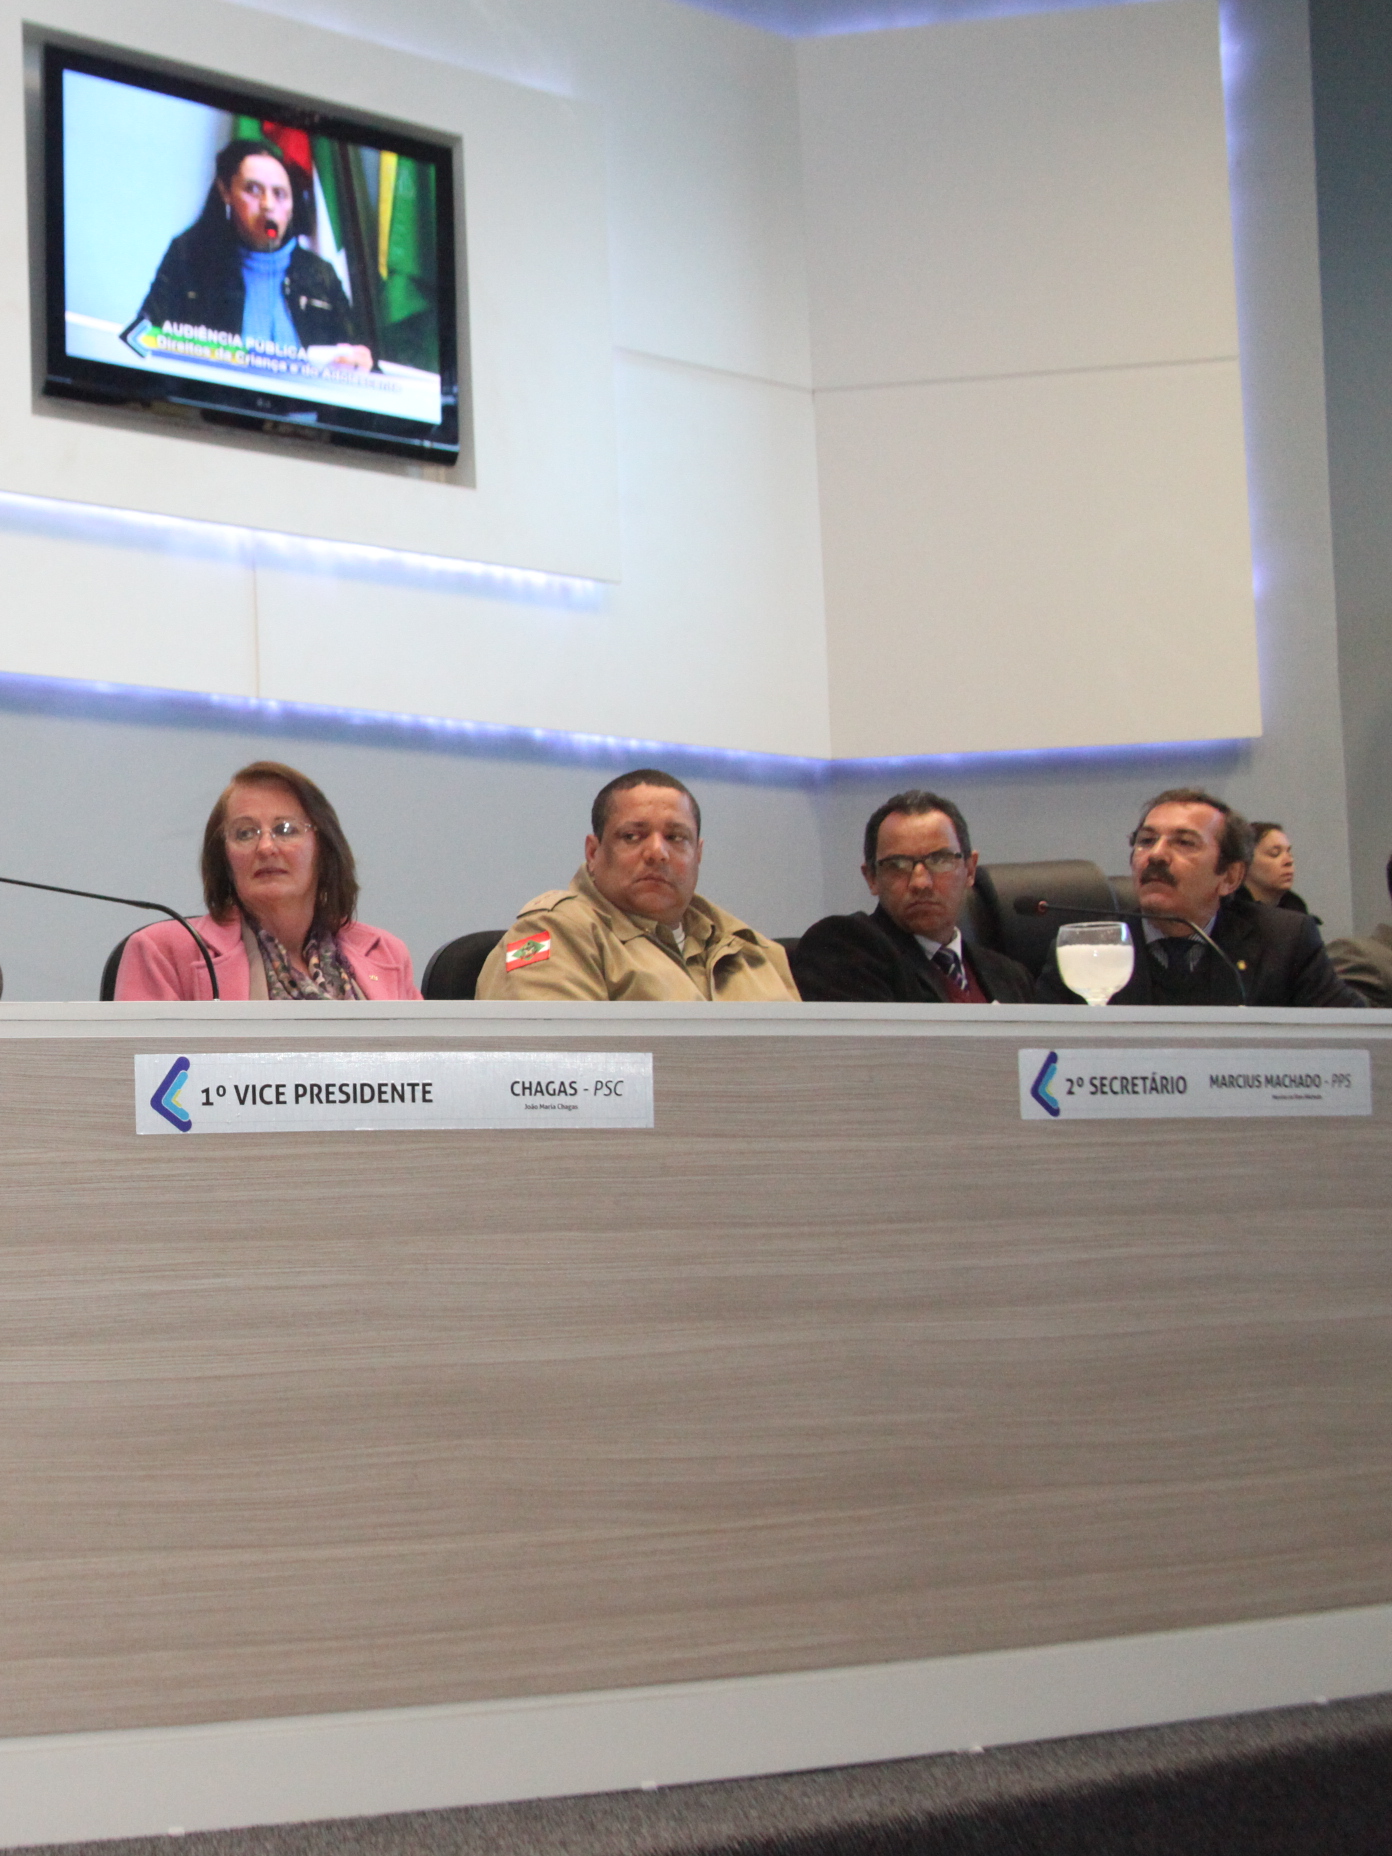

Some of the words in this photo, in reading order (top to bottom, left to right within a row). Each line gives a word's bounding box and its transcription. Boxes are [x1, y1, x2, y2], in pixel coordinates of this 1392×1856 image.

[161, 319, 243, 348] AUDIÊNCIA
[156, 334, 211, 358] Direitos
[510, 1080, 578, 1097] CHAGAS
[593, 1080, 625, 1097] PSC
[1088, 1071, 1188, 1096] SECRETÁRIO
[1209, 1073, 1263, 1089] MARCIUS
[1264, 1073, 1323, 1089] MACHADO
[1330, 1073, 1352, 1089] PPS
[233, 1083, 288, 1106] VICE
[294, 1082, 434, 1105] PRESIDENTE
[557, 1103, 579, 1112] Chagas
